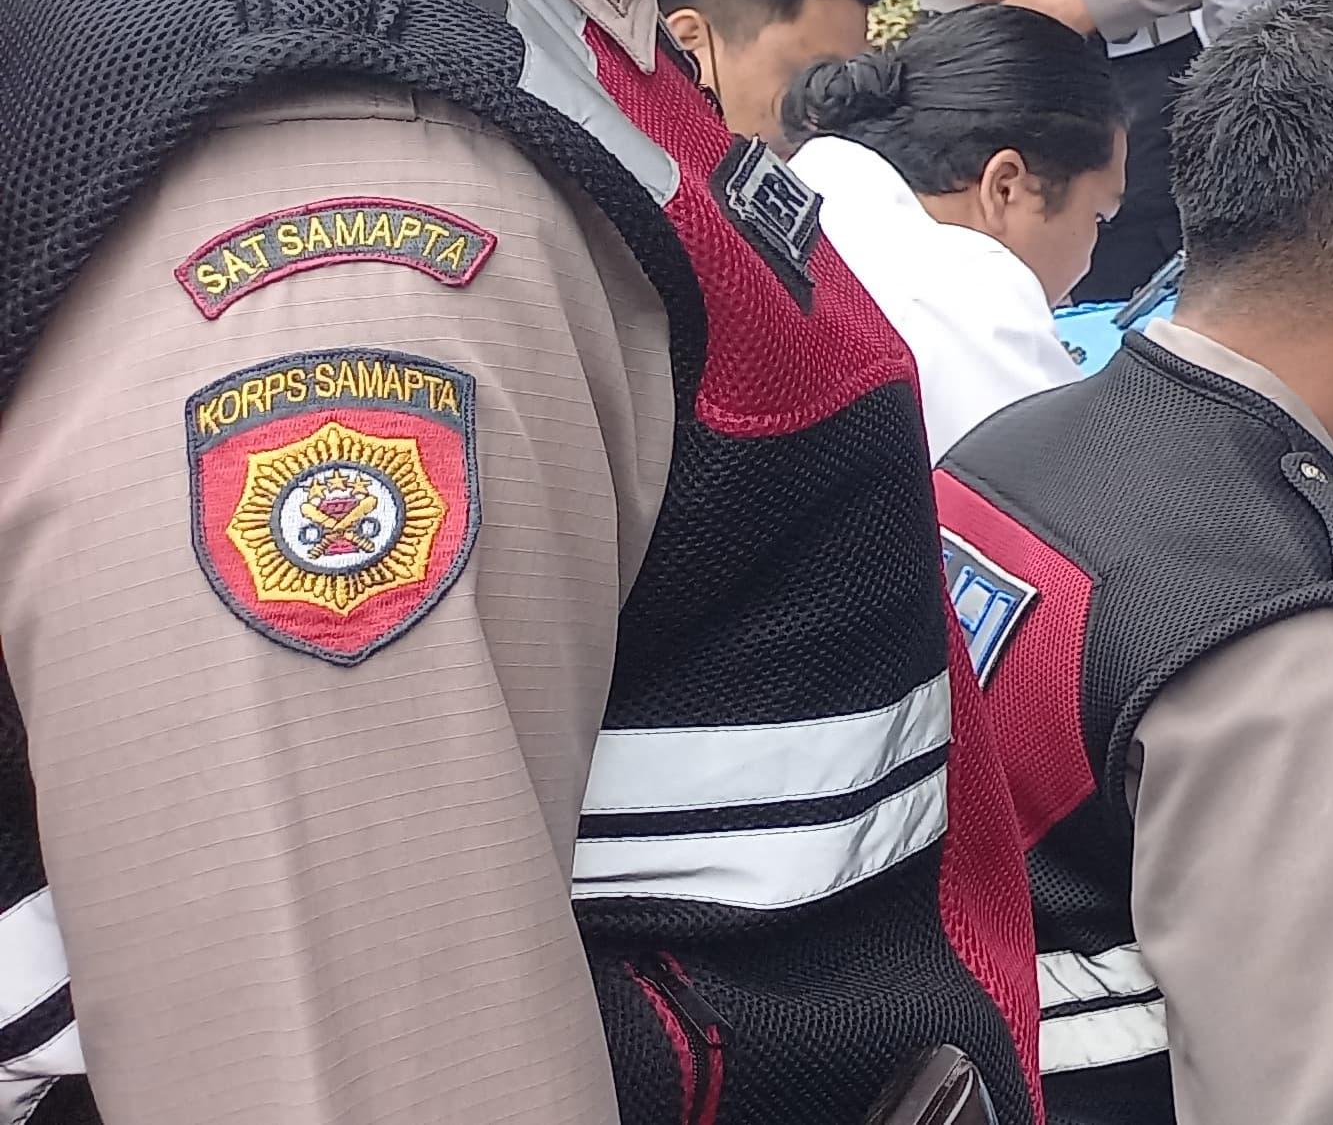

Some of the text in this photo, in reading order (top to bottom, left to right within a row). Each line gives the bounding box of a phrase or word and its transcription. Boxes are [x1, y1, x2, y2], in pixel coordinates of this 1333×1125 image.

[197, 212, 468, 295] SAT SAMAPTA
[195, 359, 461, 436] KORPS SAMAPTA
